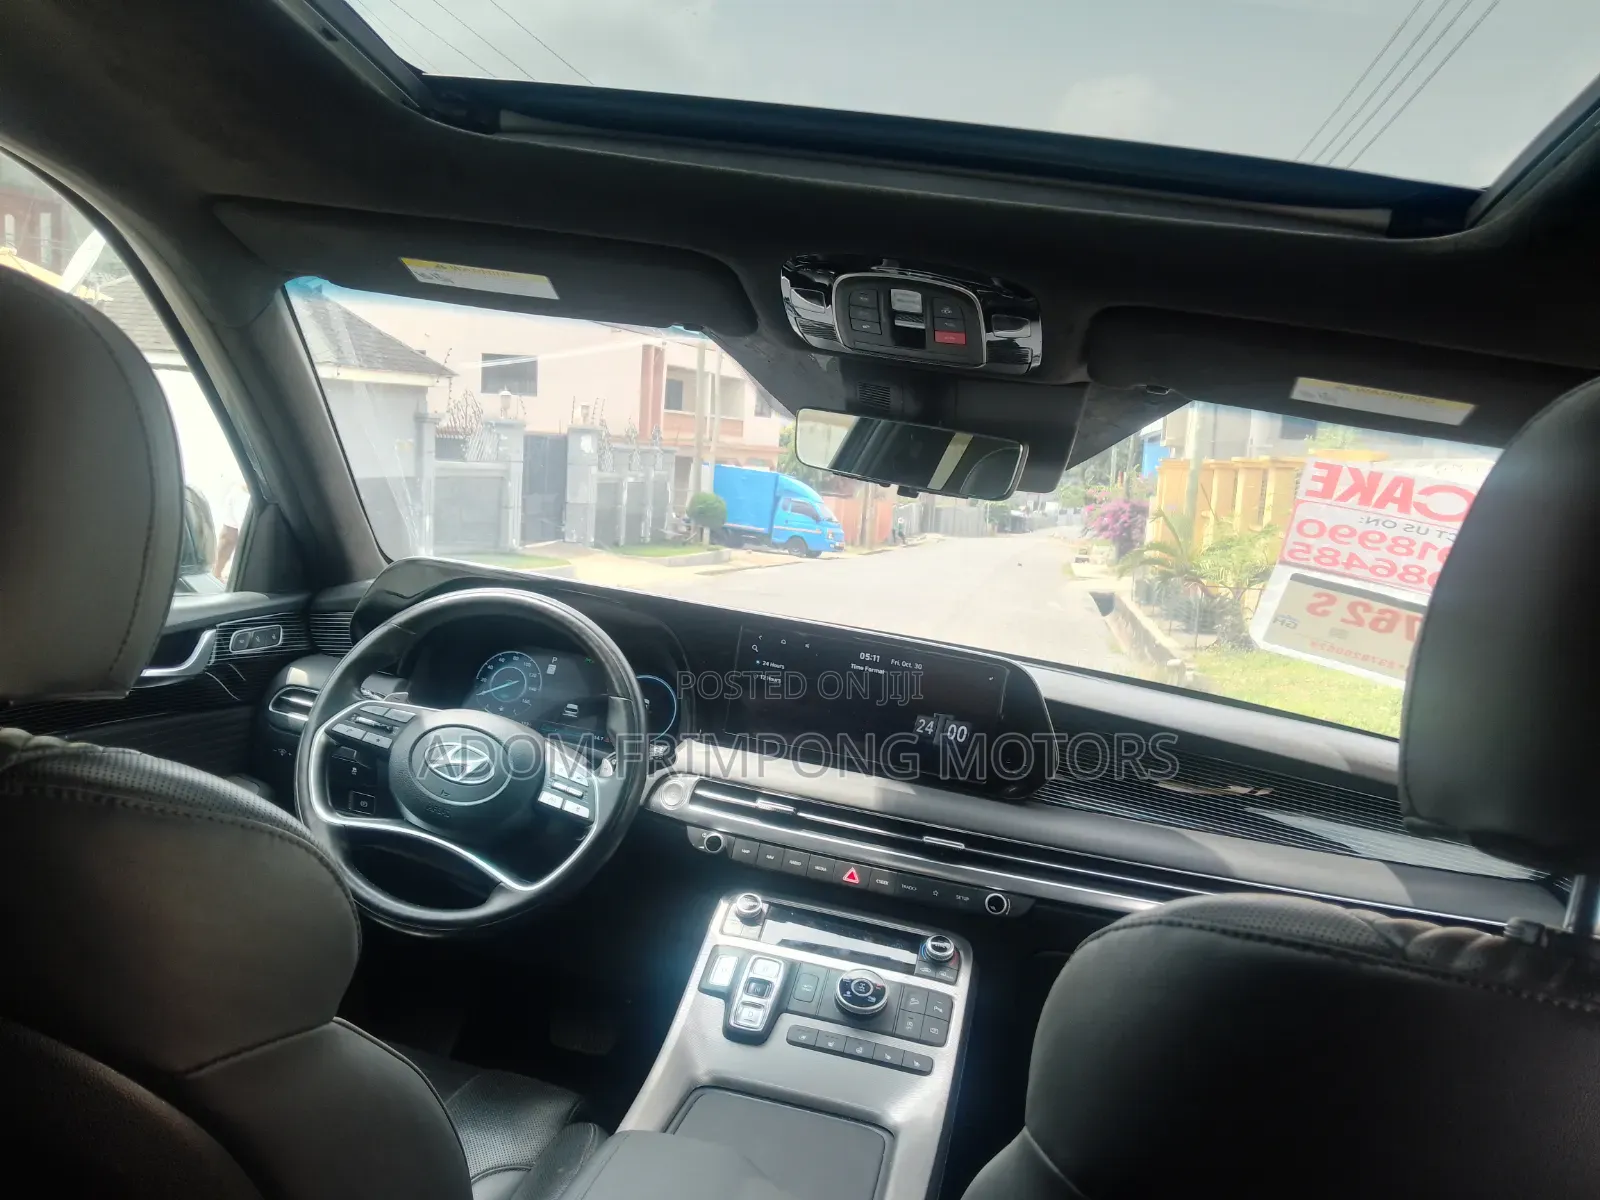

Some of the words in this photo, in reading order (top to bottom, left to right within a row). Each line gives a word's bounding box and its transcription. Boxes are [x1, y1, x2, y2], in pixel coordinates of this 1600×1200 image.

[859, 652, 881, 663] 05:11
[770, 662, 785, 670] Hours
[850, 663, 864, 671] Time
[865, 666, 885, 674] Format
[914, 662, 923, 670] 30
[916, 719, 934, 735] 24
[947, 723, 969, 743] 00
